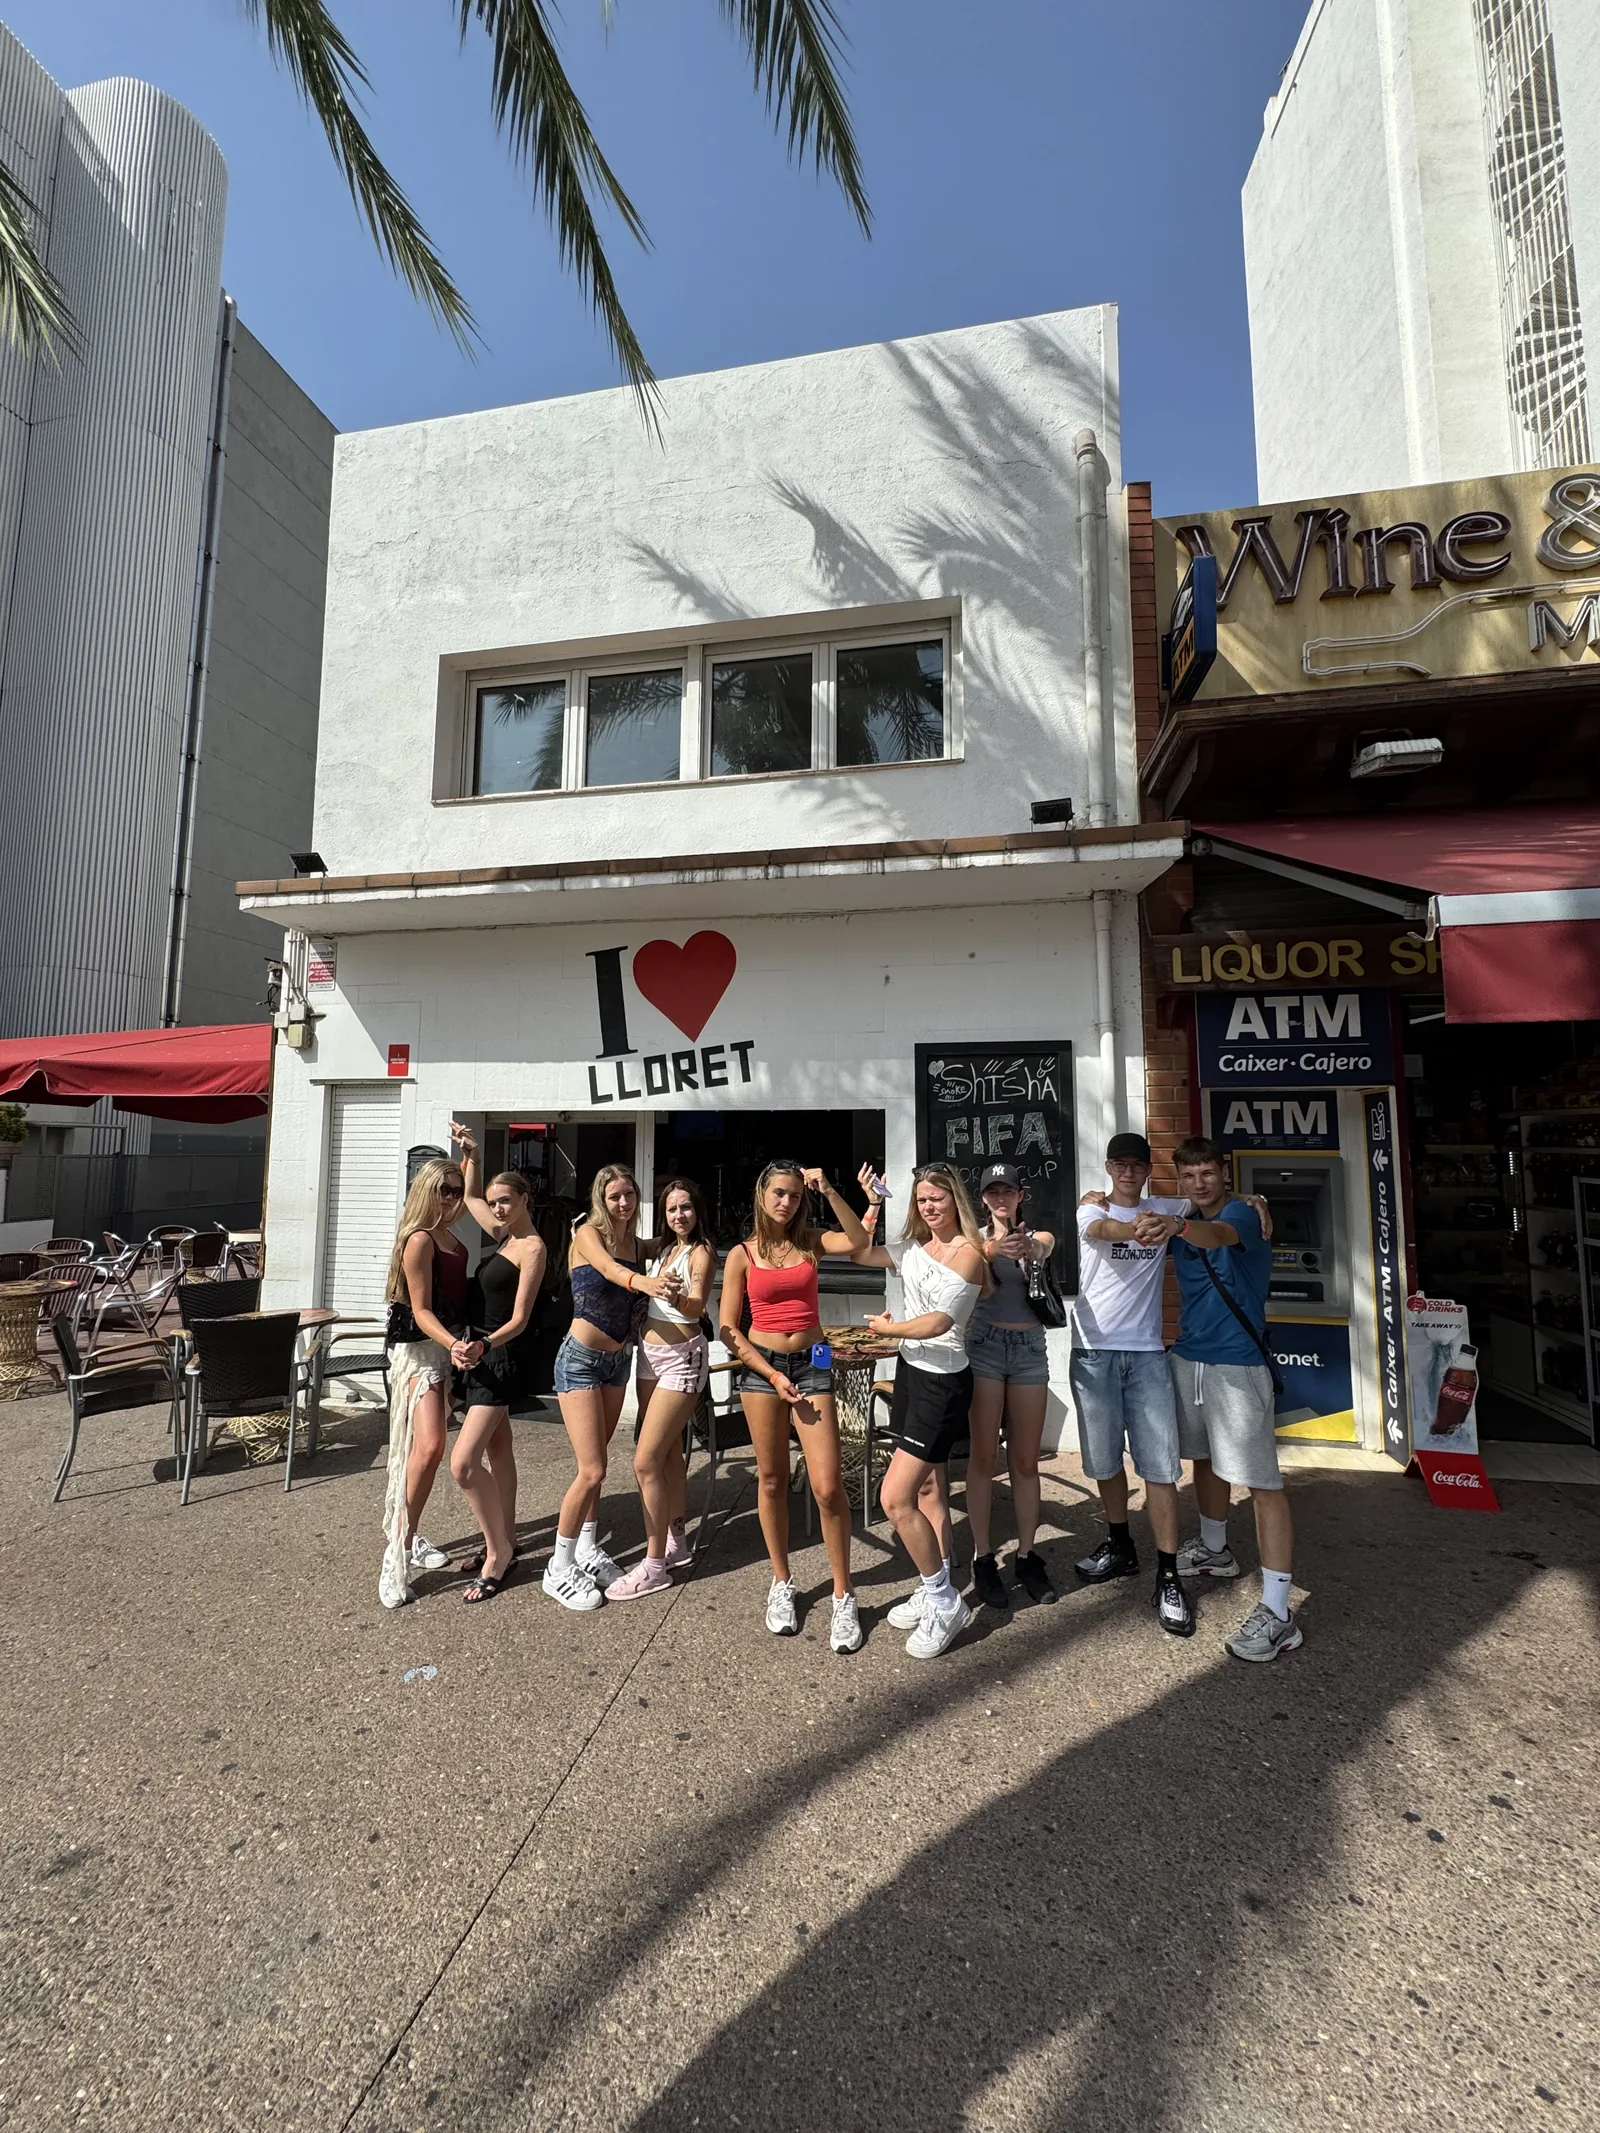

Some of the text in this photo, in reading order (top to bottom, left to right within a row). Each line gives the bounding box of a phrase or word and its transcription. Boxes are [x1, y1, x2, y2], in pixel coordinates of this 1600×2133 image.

[1175, 507, 1511, 610] Wine
[1536, 473, 1600, 571] &
[1173, 619, 1194, 690] ATM
[1172, 939, 1365, 983] LIQUOR
[585, 945, 638, 1059] I
[1225, 994, 1362, 1040] ATM
[588, 1040, 755, 1105] LLORET
[946, 1112, 1053, 1158] FIFA
[1223, 1101, 1328, 1135] ATM
[992, 1165, 1005, 1176] NY
[1110, 1248, 1158, 1260] BLOWJOBS
[1432, 1470, 1483, 1488] Coca-Cola
